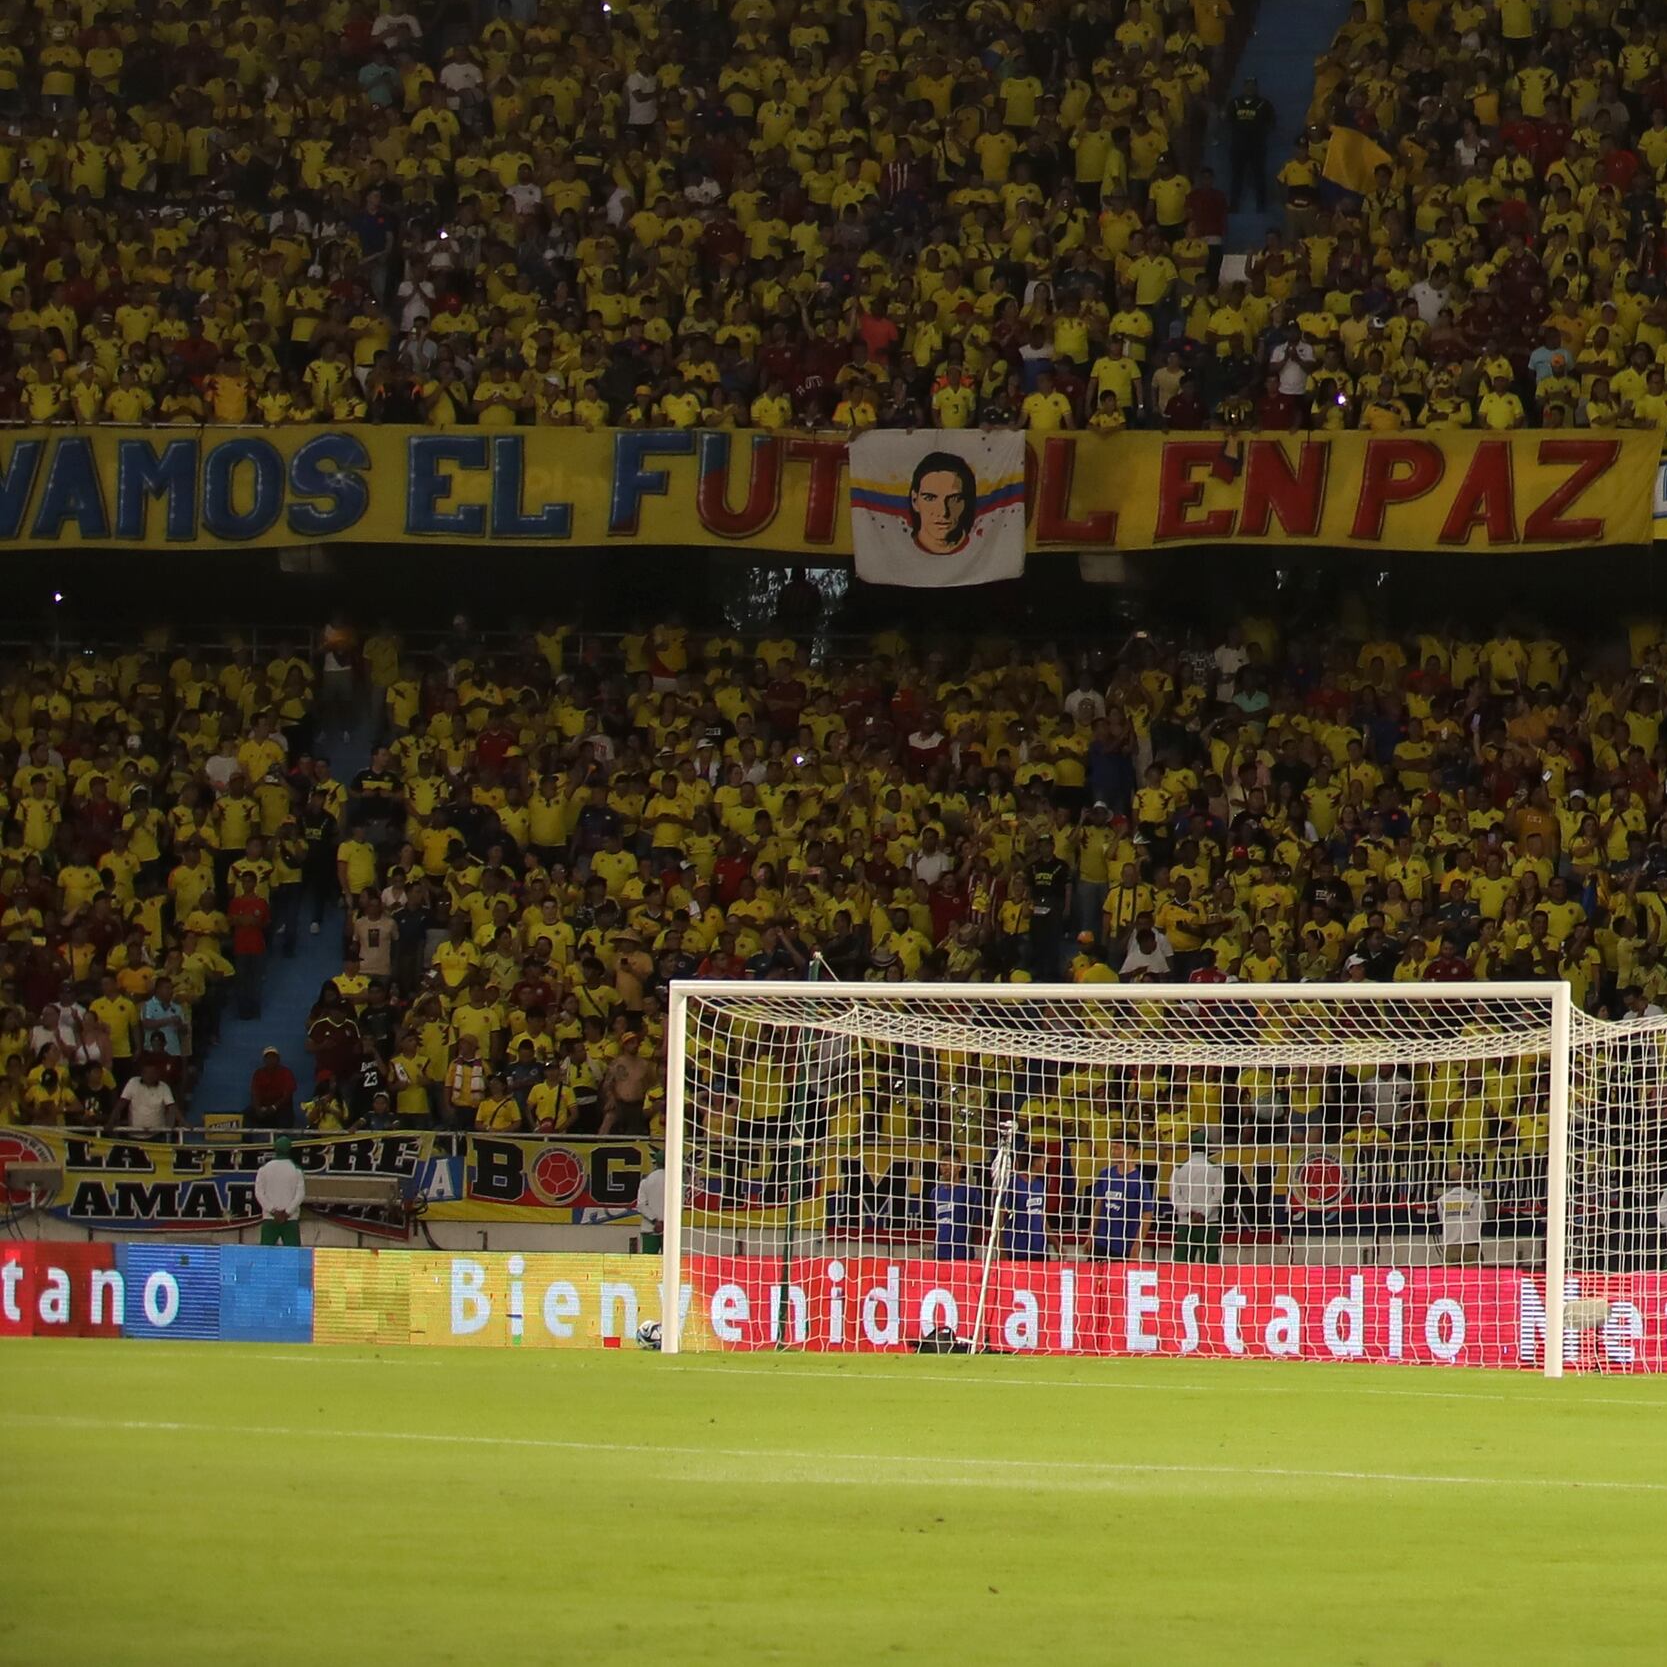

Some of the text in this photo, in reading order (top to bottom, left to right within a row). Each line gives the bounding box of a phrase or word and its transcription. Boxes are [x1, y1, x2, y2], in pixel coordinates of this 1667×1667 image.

[0, 430, 1623, 545] VAMOS EL FUTL EN PAZ
[363, 1071, 378, 1088] 23
[66, 1138, 155, 1173] LA
[451, 1254, 959, 1347] Bienvenido
[1004, 1268, 1076, 1351] al
[1125, 1268, 1466, 1360] Estadio
